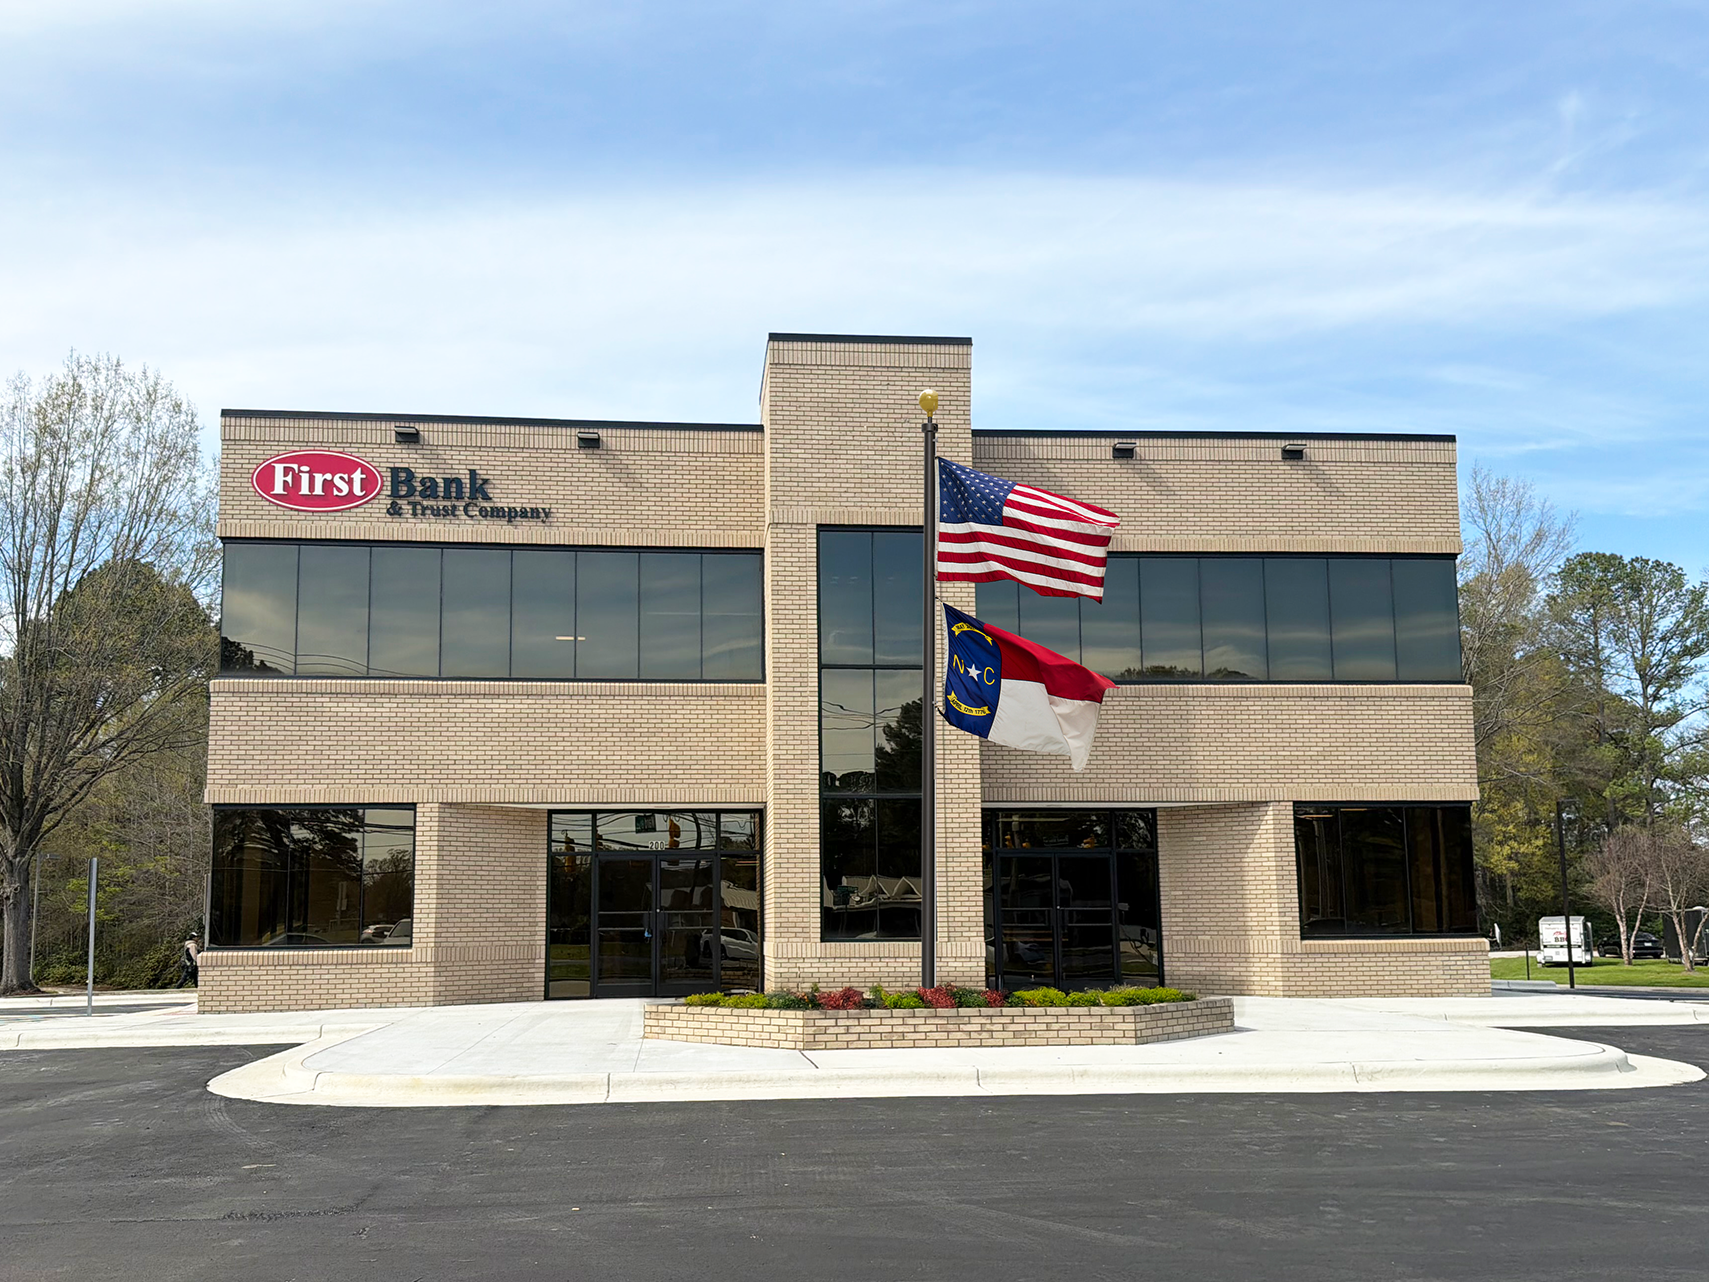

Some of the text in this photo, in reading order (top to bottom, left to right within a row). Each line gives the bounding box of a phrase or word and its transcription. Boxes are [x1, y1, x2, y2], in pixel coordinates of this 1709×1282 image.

[270, 463, 492, 500] First Bank
[386, 501, 551, 523] & Trust Company
[953, 654, 995, 685] N C
[649, 841, 665, 850] 200
